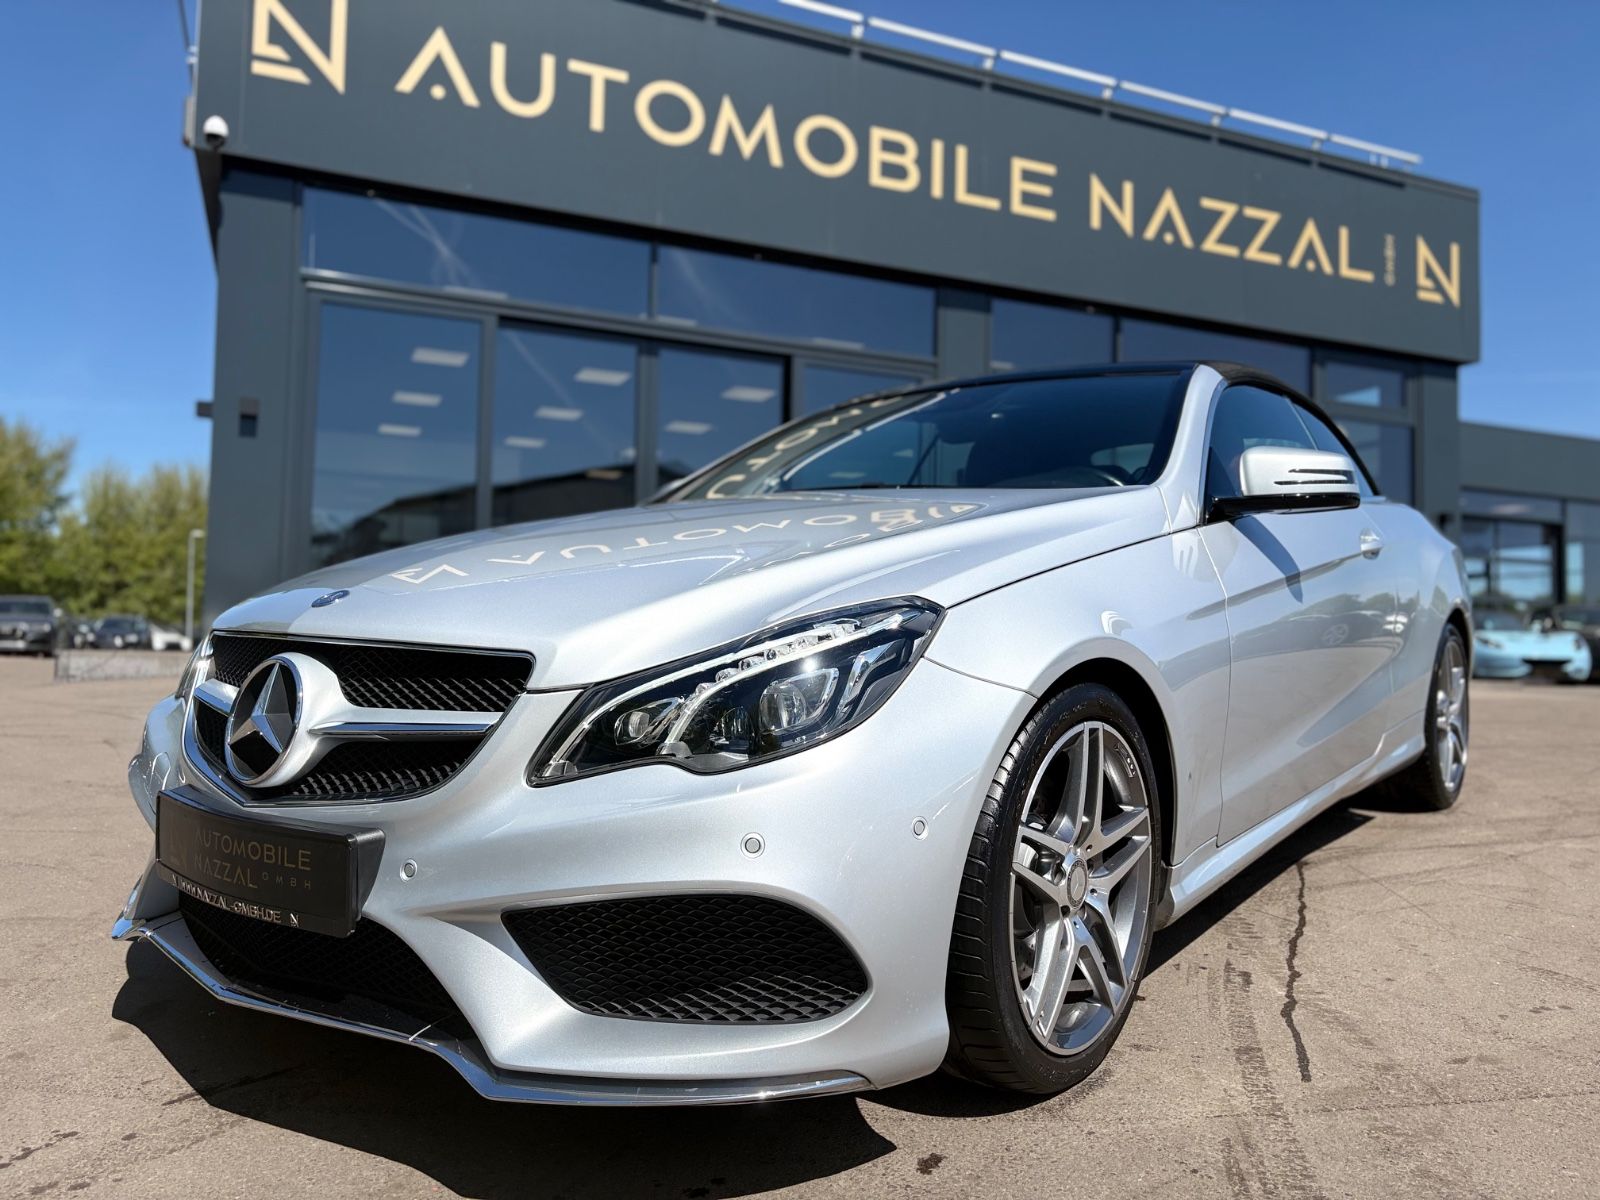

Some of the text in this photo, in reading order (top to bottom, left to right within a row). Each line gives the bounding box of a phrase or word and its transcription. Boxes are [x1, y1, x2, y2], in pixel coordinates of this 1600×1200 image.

[395, 27, 1057, 221] AUTOMOBILE
[1089, 174, 1376, 283] NAZZAL
[1415, 236, 1461, 307] N
[194, 829, 312, 871] AUTOMOBILE
[194, 853, 258, 889] NAZZAL
